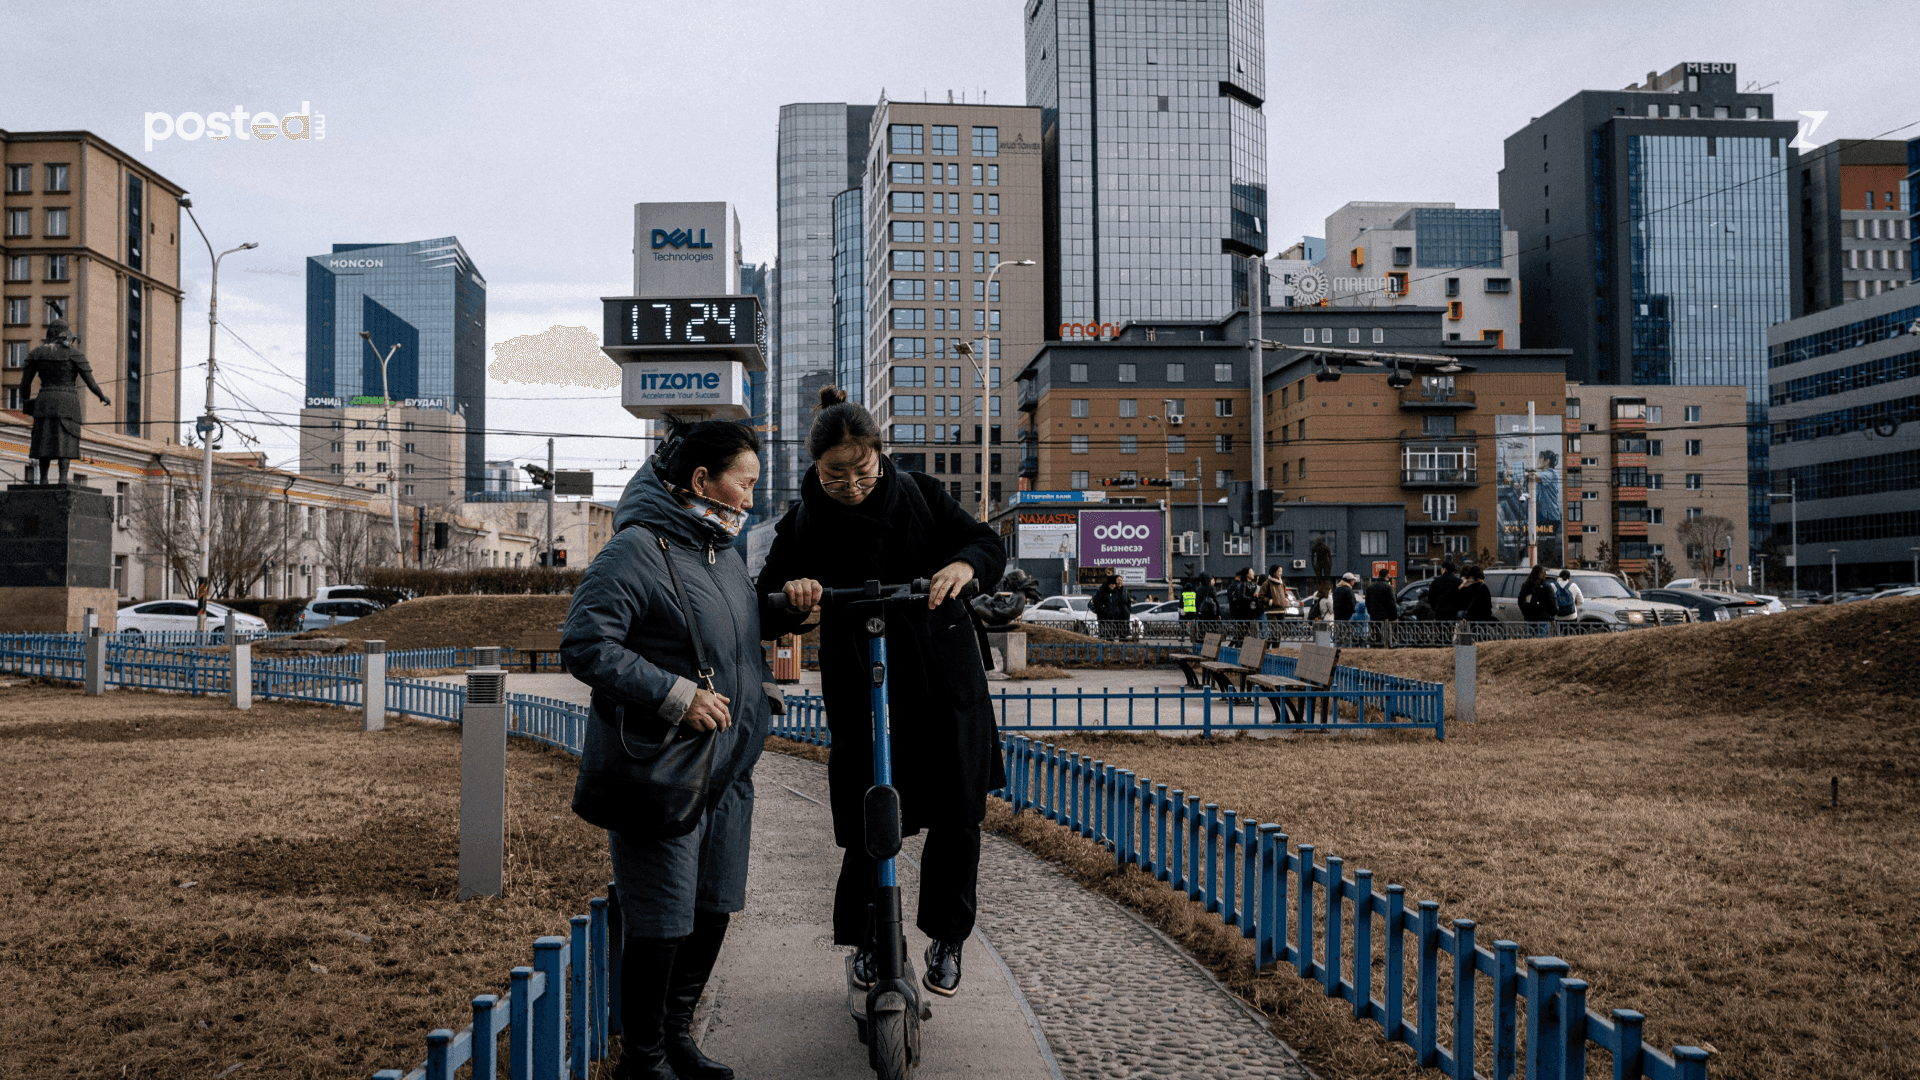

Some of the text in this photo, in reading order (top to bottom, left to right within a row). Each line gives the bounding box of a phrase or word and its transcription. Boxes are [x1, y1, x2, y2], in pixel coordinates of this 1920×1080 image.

[1687, 62, 1734, 74] MERU
[652, 228, 713, 249] DELL
[653, 252, 714, 263] Technologies
[330, 259, 384, 268] MONCON
[641, 391, 720, 399] Accelerate Your Success
[307, 397, 342, 407] ЗОЧИД
[404, 398, 443, 407] БУУДАЛ
[1094, 520, 1150, 540] odoo
[1100, 543, 1143, 553] Бизнесээ
[1093, 556, 1151, 567] цахимжуул!
